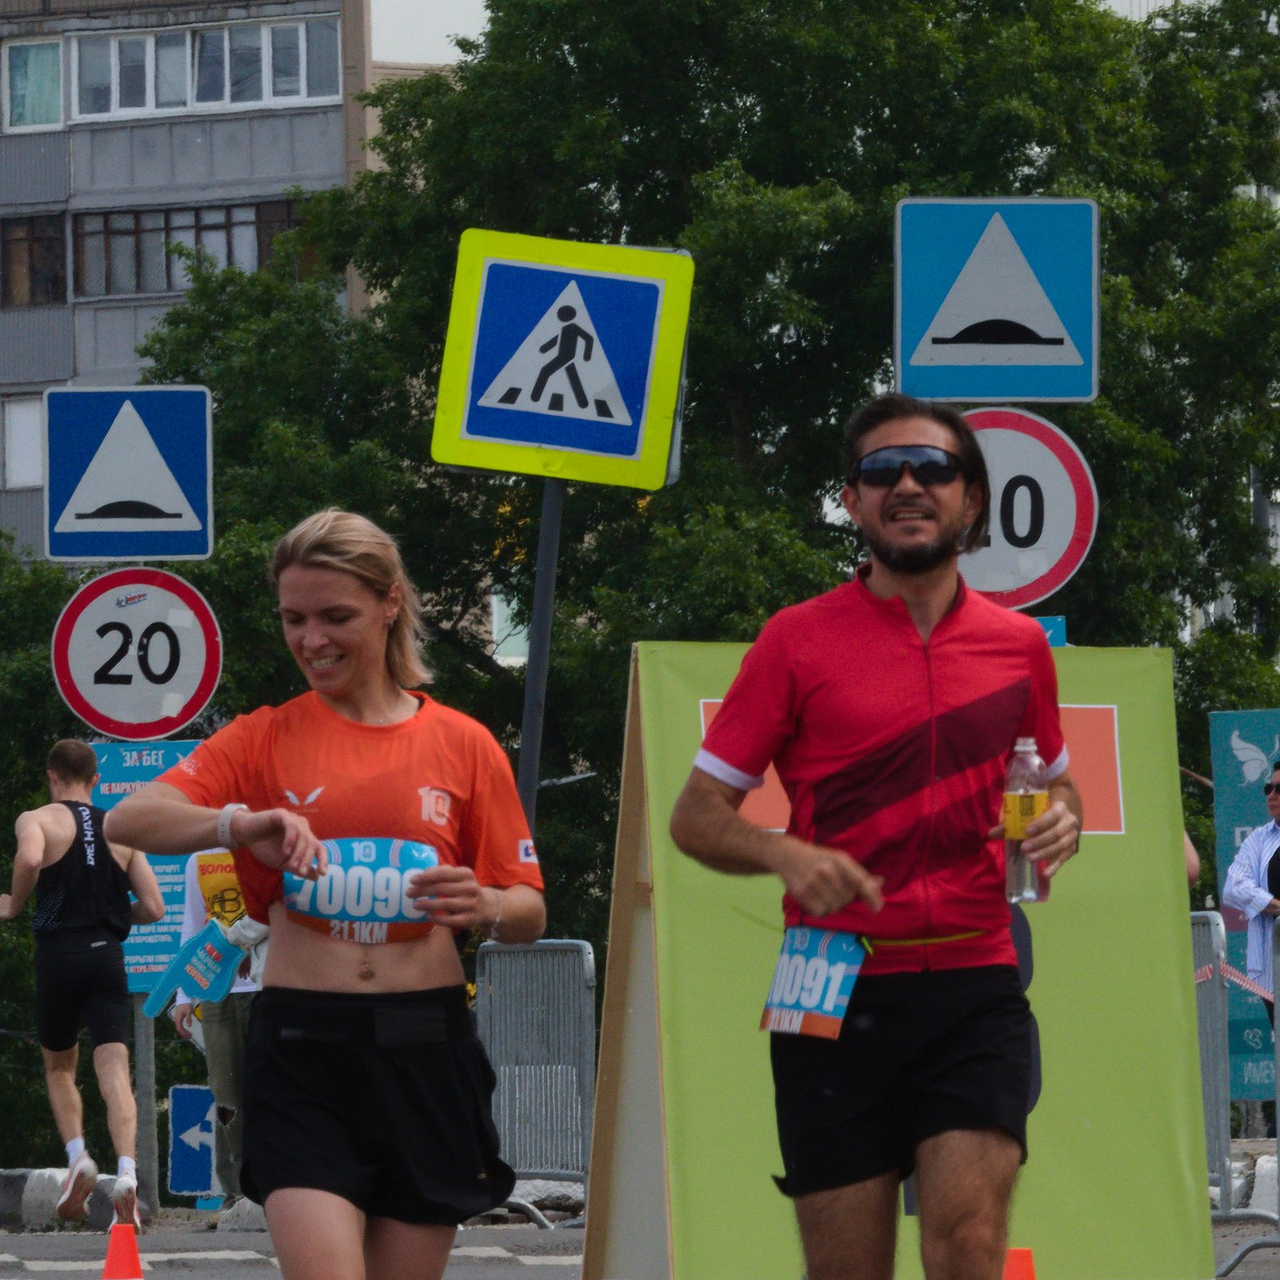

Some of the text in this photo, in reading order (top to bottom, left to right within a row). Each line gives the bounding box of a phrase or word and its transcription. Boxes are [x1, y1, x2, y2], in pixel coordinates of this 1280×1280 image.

[984, 474, 1044, 549] 0
[93, 621, 181, 685] 20
[769, 953, 847, 1013] 0091
